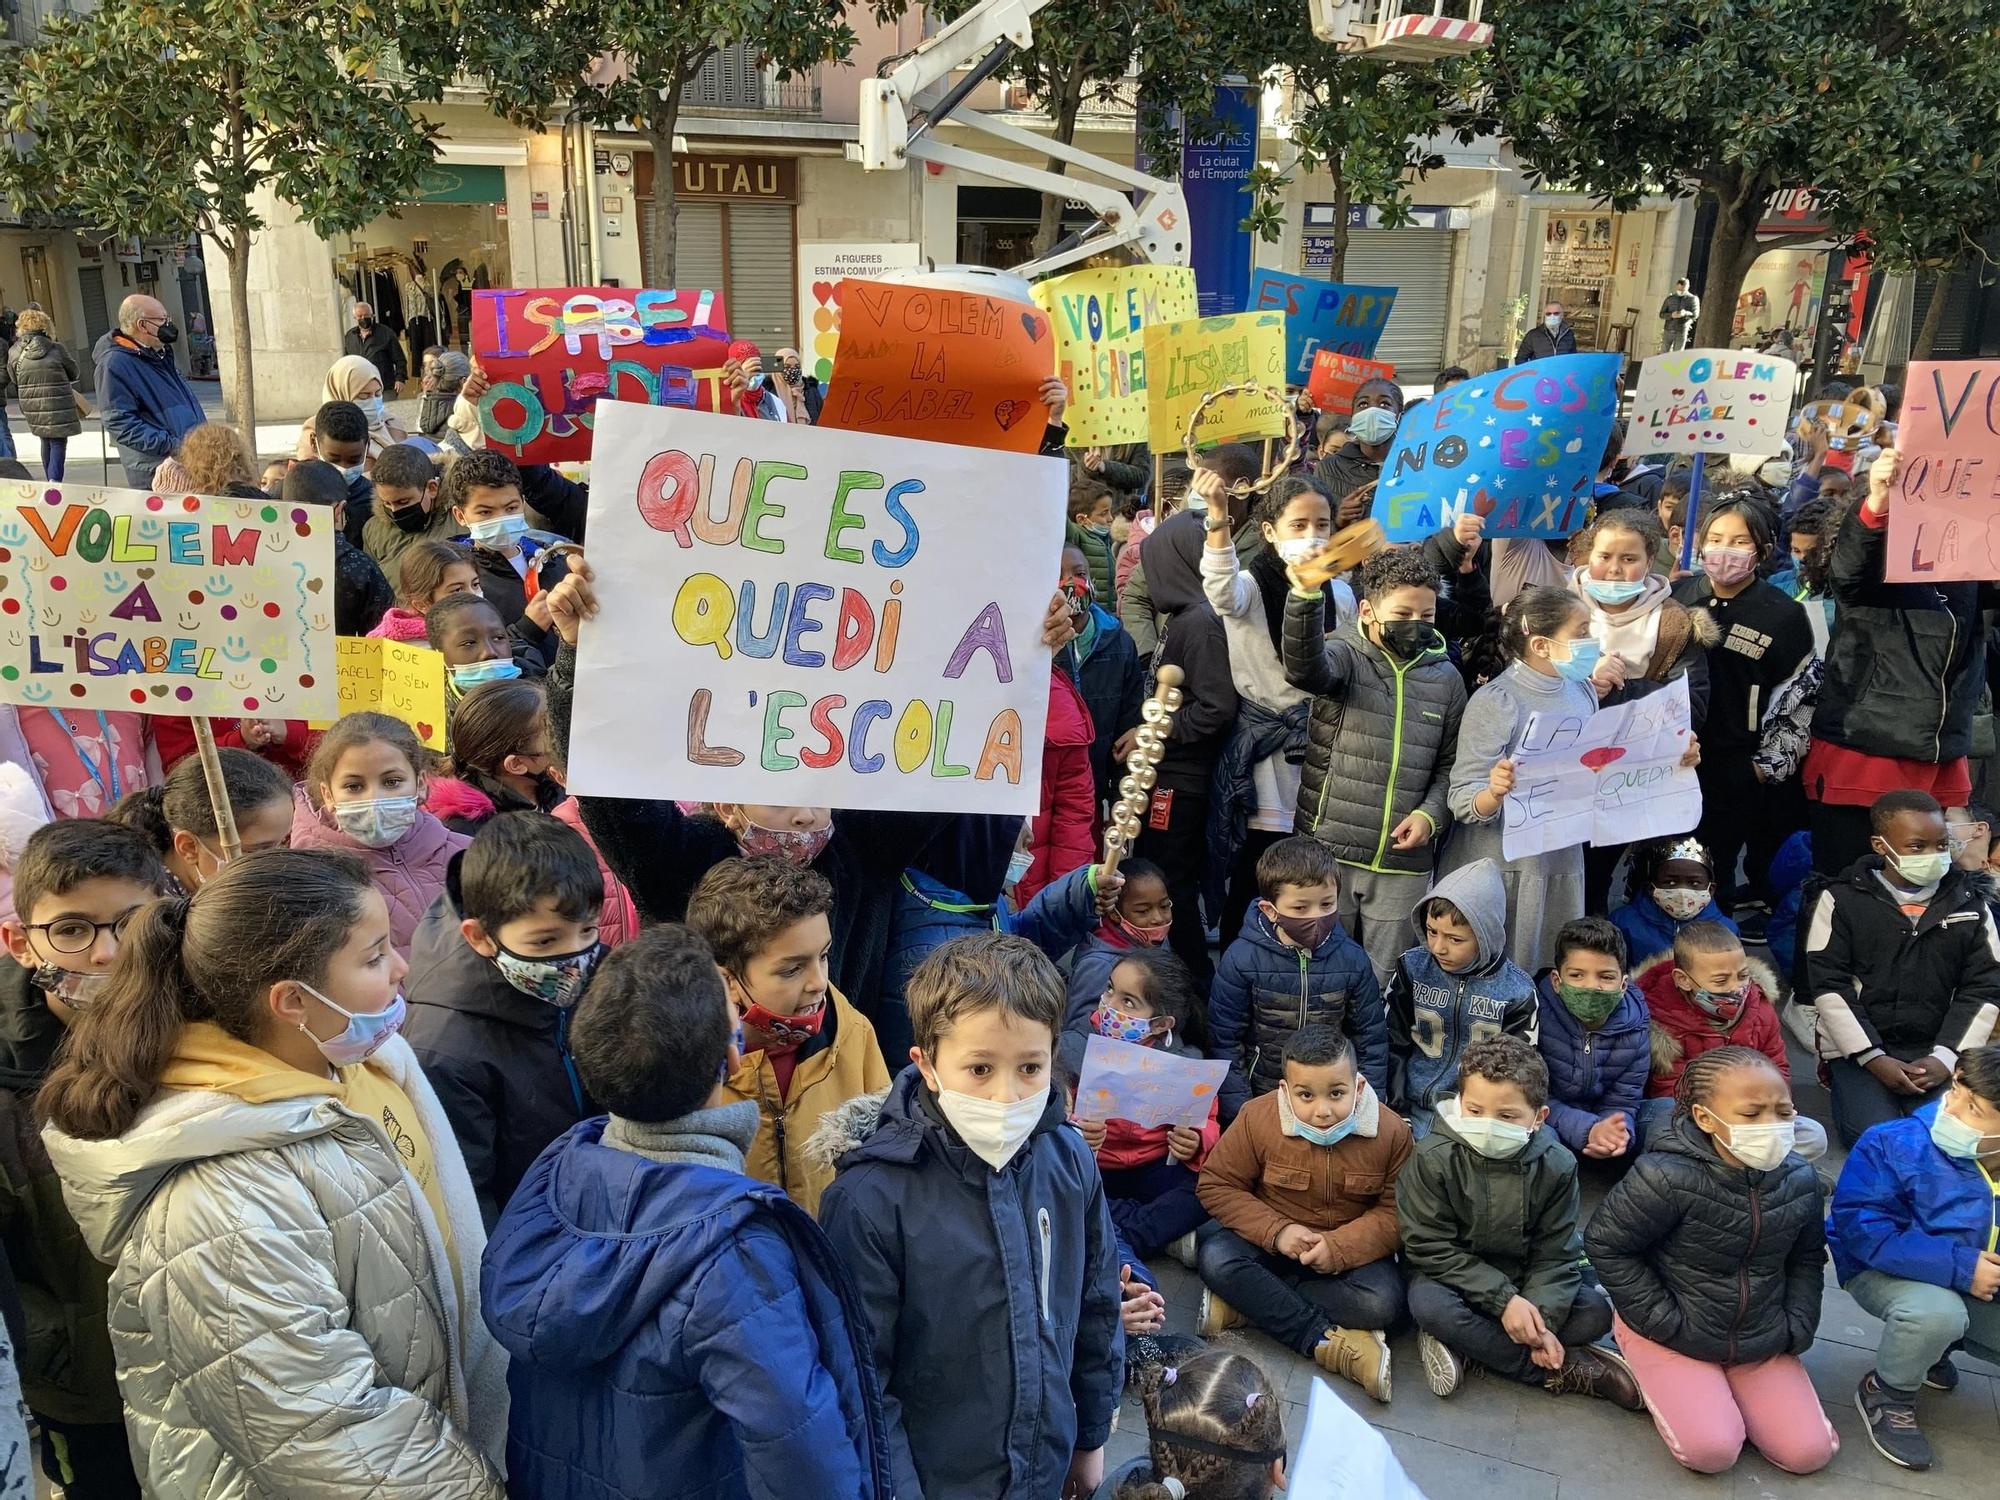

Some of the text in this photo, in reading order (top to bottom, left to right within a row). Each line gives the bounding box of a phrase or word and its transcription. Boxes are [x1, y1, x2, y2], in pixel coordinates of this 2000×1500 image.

[672, 160, 778, 194] UTAU
[1188, 167, 1200, 179] de
[1200, 155, 1240, 167] La ciutat
[814, 266, 846, 276] ESTIMA
[846, 266, 867, 276] COM
[842, 254, 883, 264] FIGUERES
[473, 288, 731, 361] ISABEL
[856, 287, 1006, 340] VOLEM
[1062, 286, 1165, 344] VOLEM
[910, 341, 946, 384] LA
[1661, 357, 1777, 383] VOLEM
[1691, 388, 1708, 405] A
[1394, 428, 1560, 478] NO ES
[1902, 454, 1983, 506] QUE
[637, 449, 926, 568] QUE ES
[16, 503, 262, 567] VOLEM
[1911, 519, 1961, 572] LA
[109, 581, 162, 622] A
[392, 648, 420, 666] QUE
[943, 601, 1013, 683] A
[393, 693, 413, 712] US
[687, 689, 1023, 785] L'ESCOLA
[1521, 716, 1583, 751] LA
[1507, 765, 1674, 828] SE QUEDA
